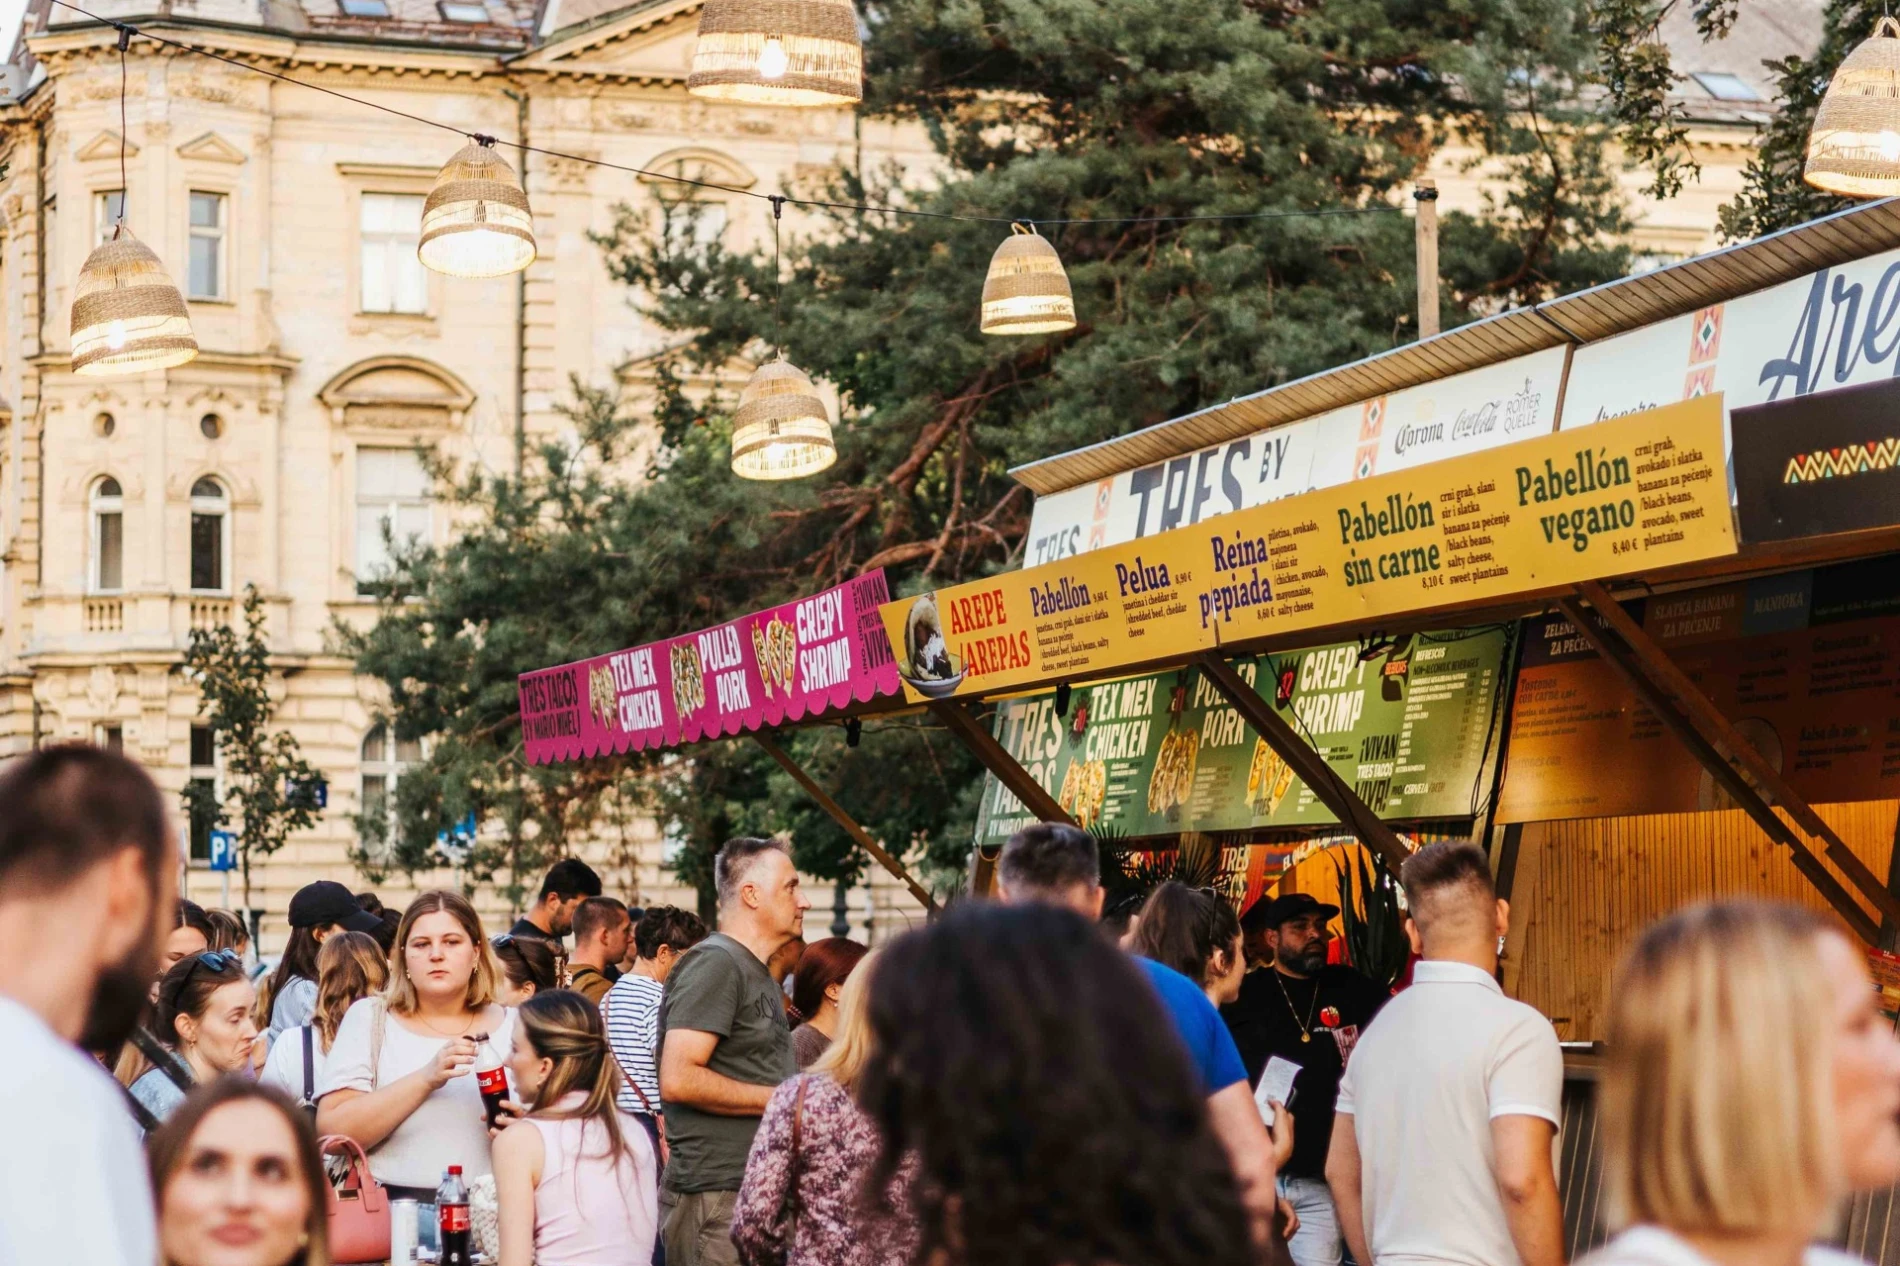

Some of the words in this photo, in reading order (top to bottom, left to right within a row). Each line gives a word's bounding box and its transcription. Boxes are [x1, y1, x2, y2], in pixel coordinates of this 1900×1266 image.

[1758, 261, 1900, 402] Are
[1503, 410, 1538, 434] QUELLE
[1394, 421, 1444, 456] Corona
[1634, 440, 1652, 456] crni
[1653, 436, 1676, 457] grah,
[1636, 456, 1671, 475] avokado
[1672, 454, 1676, 467] i
[1677, 448, 1703, 465] slatka
[1130, 437, 1251, 539] TRES
[1259, 434, 1290, 484] BY
[1515, 446, 1632, 507] Pabellón
[1637, 480, 1669, 493] banana
[1670, 476, 1680, 486] za
[1440, 488, 1455, 502] crni
[1456, 484, 1476, 503] grah,
[1477, 479, 1495, 494] slani
[1666, 492, 1695, 505] beans,
[1337, 491, 1435, 545] Pabellón
[1442, 506, 1451, 519] sir
[1453, 505, 1456, 516] i
[1457, 501, 1480, 515] slatka
[1642, 510, 1679, 529] avocado,
[1680, 507, 1705, 521] sweet
[1293, 520, 1320, 535] avokado,
[1443, 522, 1470, 535] banana
[1472, 521, 1480, 530] za
[1539, 499, 1635, 552] vegano
[1211, 529, 1268, 572] Reina
[1469, 535, 1494, 548] beans,
[1612, 539, 1630, 556] 8,40
[1632, 538, 1638, 550] €
[1643, 528, 1684, 551] plantains
[1271, 560, 1275, 571] i
[1275, 557, 1289, 570] slani
[1290, 555, 1298, 567] sir
[1301, 565, 1328, 580] avocado,
[1344, 548, 1375, 587] sin
[1378, 543, 1441, 581] carne
[1448, 555, 1465, 570] salty
[1467, 551, 1494, 564] cheese,
[1115, 556, 1171, 597] Pelua
[1188, 571, 1192, 581] €
[1422, 575, 1438, 590] 8,10
[1439, 574, 1444, 585] €
[1450, 571, 1471, 585] sweet
[1472, 564, 1509, 584] plantains
[1030, 576, 1091, 618] Pabellón
[1104, 590, 1109, 600] €
[1148, 592, 1169, 606] cheddar
[1166, 602, 1187, 615] cheddar
[1199, 568, 1273, 629] pepiada
[1278, 604, 1292, 618] salty
[1294, 601, 1314, 613] cheese
[1654, 600, 1692, 620] SLATKA
[1693, 593, 1736, 615] BANANA
[1753, 591, 1804, 615] MANIOKA
[796, 588, 843, 645] CRISPY
[950, 589, 1007, 635] AREPE
[1270, 607, 1275, 617] €
[1128, 627, 1145, 638] cheese
[1663, 622, 1676, 639] ZA
[698, 625, 742, 673] PULLED
[960, 630, 1031, 681] /AREPAS
[1415, 647, 1447, 661] REFRESCOS
[1550, 640, 1561, 656] ZA
[1563, 635, 1594, 654] PEČEN
[610, 653, 633, 692] TEX
[630, 647, 657, 688] MEX
[800, 636, 851, 694] SHRIMP
[1300, 645, 1369, 692] CRISPY
[520, 676, 546, 714] TRES
[545, 668, 578, 710] TACOS
[715, 669, 751, 715] PORK
[1090, 683, 1120, 722] TEX
[1119, 678, 1157, 718] MEX
[619, 689, 663, 733] CHICKEN
[1294, 690, 1365, 736] SHRIMP
[523, 718, 533, 741] BY
[1007, 698, 1063, 760] TRES
[1086, 719, 1151, 762] CHICKEN
[1200, 708, 1245, 749] PORK
[1357, 763, 1374, 779] TRES
[1373, 762, 1394, 778] TACOS
[211, 837, 225, 864] P
